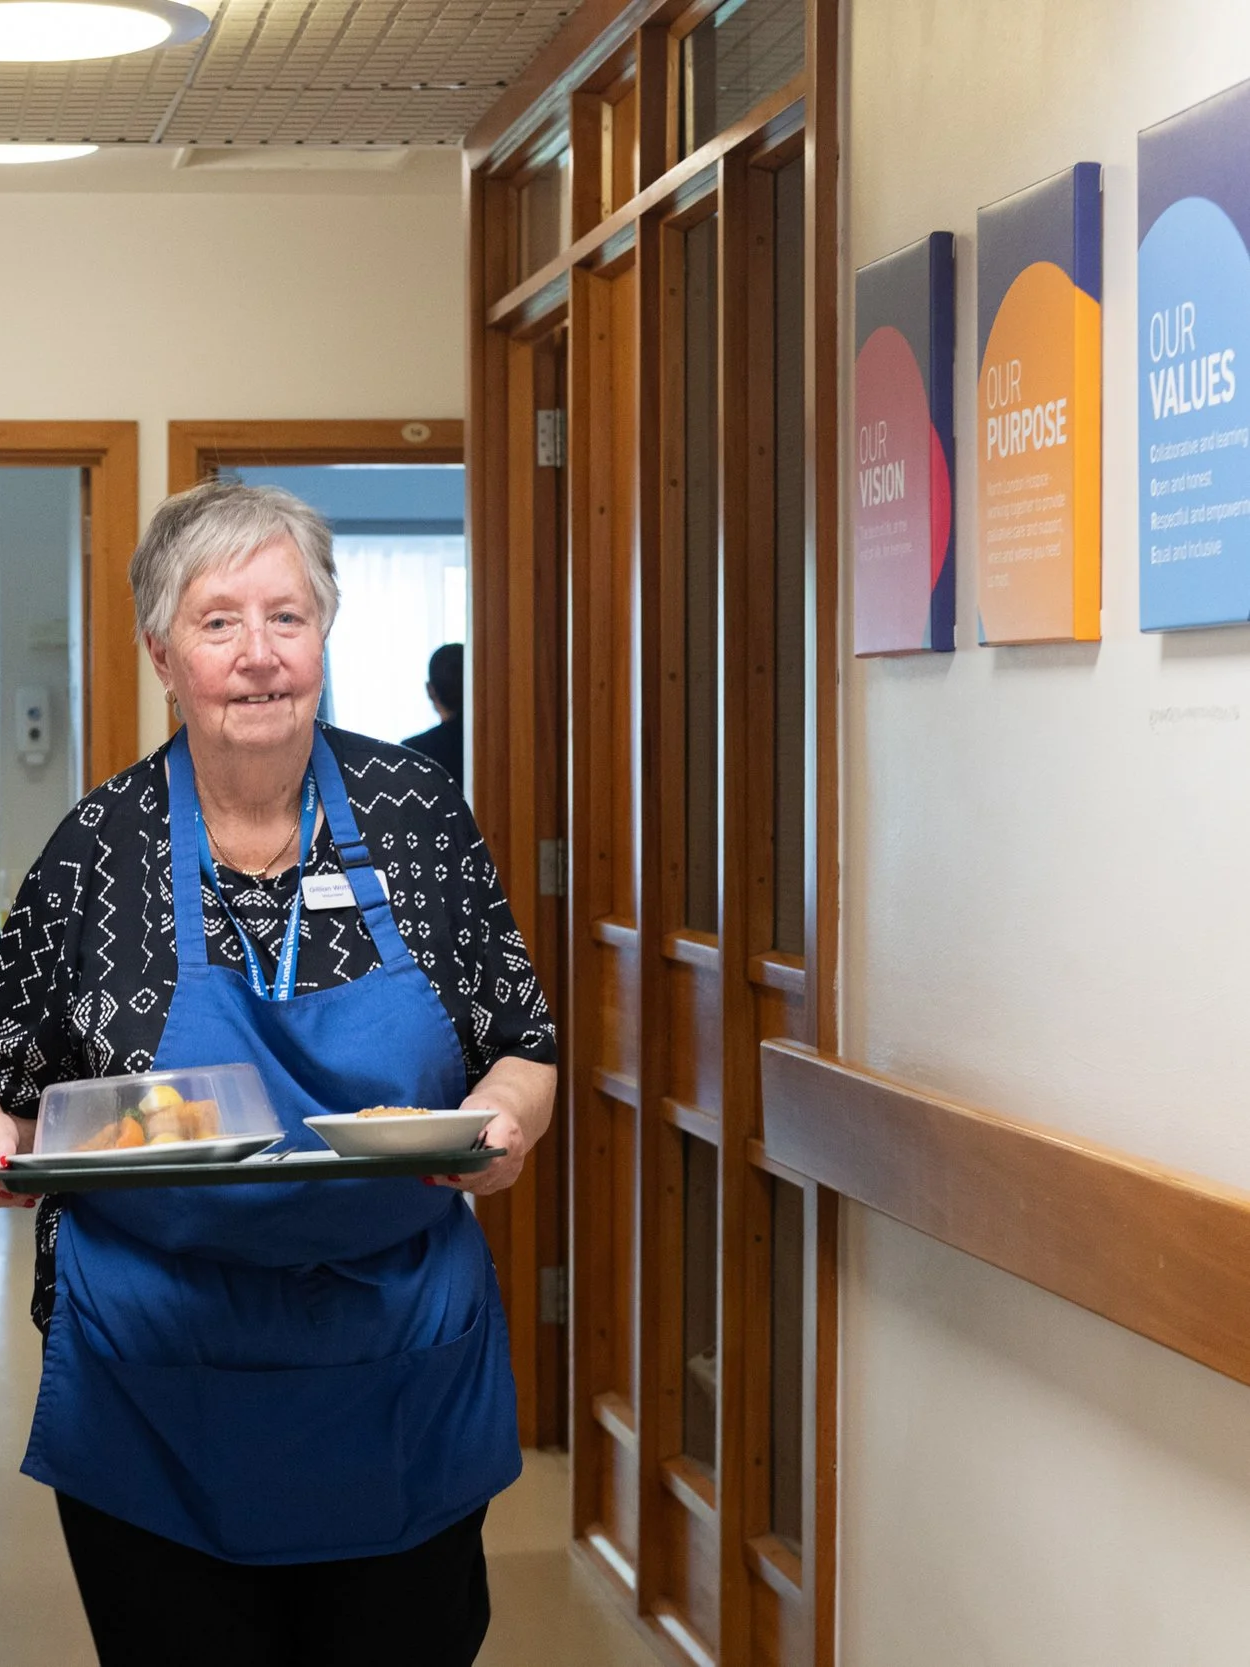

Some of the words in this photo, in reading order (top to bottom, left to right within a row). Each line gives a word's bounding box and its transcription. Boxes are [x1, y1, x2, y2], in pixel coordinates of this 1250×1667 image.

[1150, 301, 1196, 363] OUR
[987, 359, 1022, 410] OUR
[1149, 348, 1236, 421] VALUES
[859, 420, 888, 465] OUR
[987, 397, 1067, 461] PURPOSE
[1150, 437, 1199, 464] Collaborative
[1200, 431, 1214, 453] and
[1215, 427, 1248, 449] learning
[859, 459, 905, 508] VISION
[1150, 478, 1170, 499] Open
[1171, 471, 1185, 493] and
[1186, 469, 1212, 489] honest
[1151, 505, 1189, 532] Respectful
[1190, 503, 1205, 525] and
[1206, 498, 1250, 524] empowerin
[1151, 545, 1171, 566] Equal
[1172, 541, 1187, 561] and
[306, 783, 316, 813] North
[250, 964, 265, 997] Hospi
[281, 946, 294, 989] London
